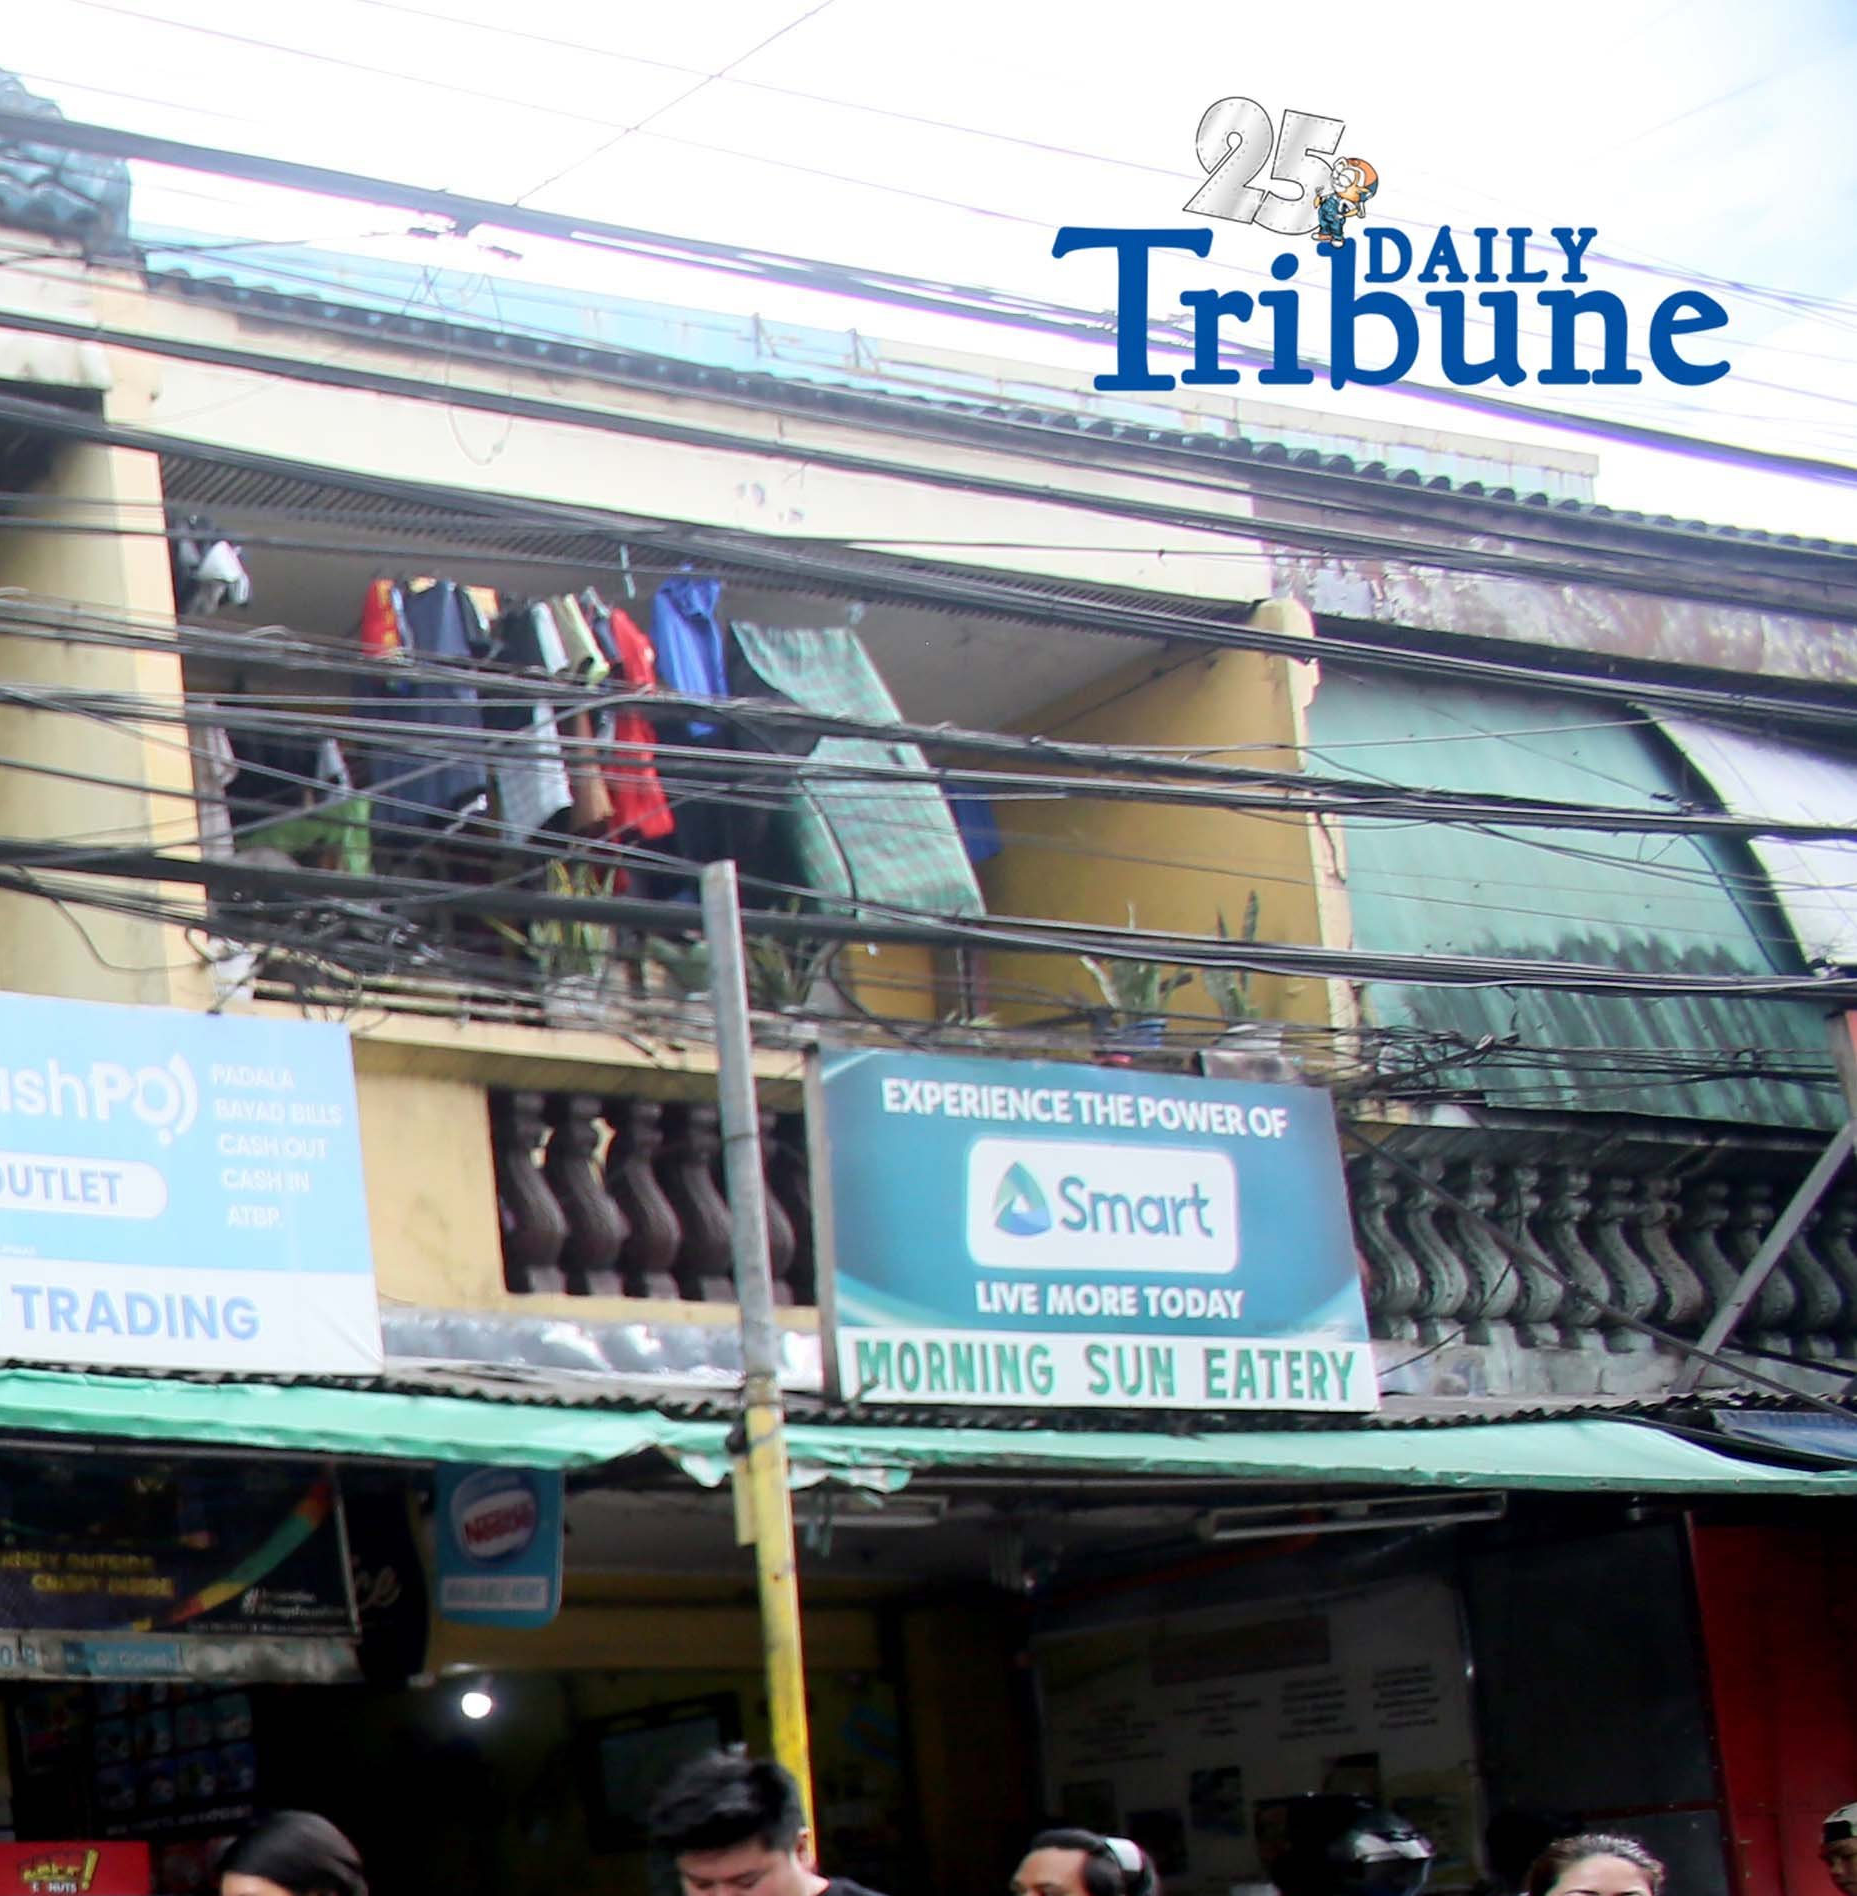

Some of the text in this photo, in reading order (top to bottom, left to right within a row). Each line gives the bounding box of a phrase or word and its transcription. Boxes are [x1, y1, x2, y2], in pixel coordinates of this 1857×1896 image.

[210, 1061, 295, 1089] PADALA
[213, 1097, 343, 1127] BAYAD BILLS
[882, 1077, 1287, 1139] EXPERIENCE THE POWER OF
[216, 1133, 327, 1160] CASH OUT
[220, 1167, 310, 1194] CASH IN
[1059, 1175, 1214, 1239] Smart
[10, 1284, 260, 1340] TRADING
[976, 1281, 1244, 1321] LIVE MORE TODAY
[856, 1339, 1356, 1402] MORNING SUN EATERY
